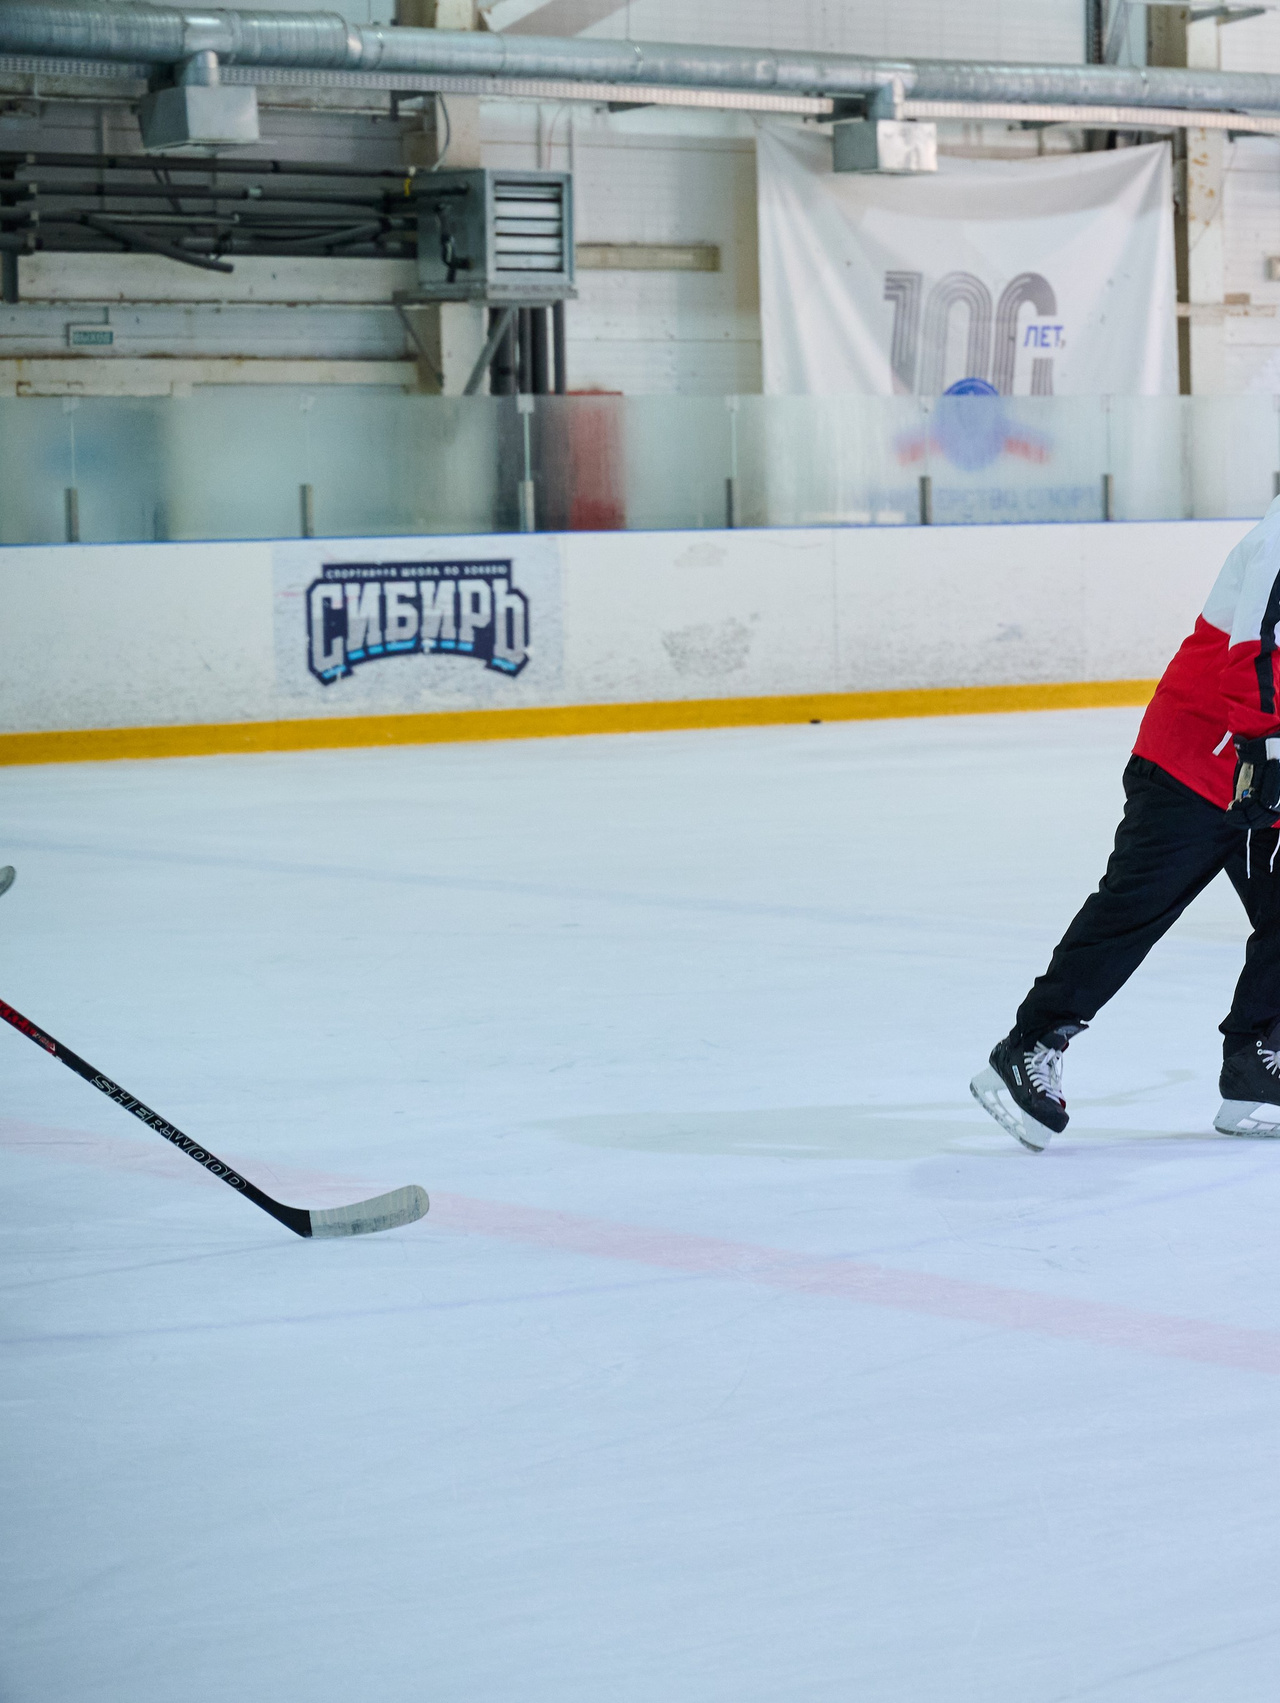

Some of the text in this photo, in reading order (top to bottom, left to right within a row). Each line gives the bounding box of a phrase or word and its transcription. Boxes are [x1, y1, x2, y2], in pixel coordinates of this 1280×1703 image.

[401, 566, 440, 578] ШКОЛА
[443, 564, 459, 576] ПО
[309, 577, 528, 680] СИБИРЬ
